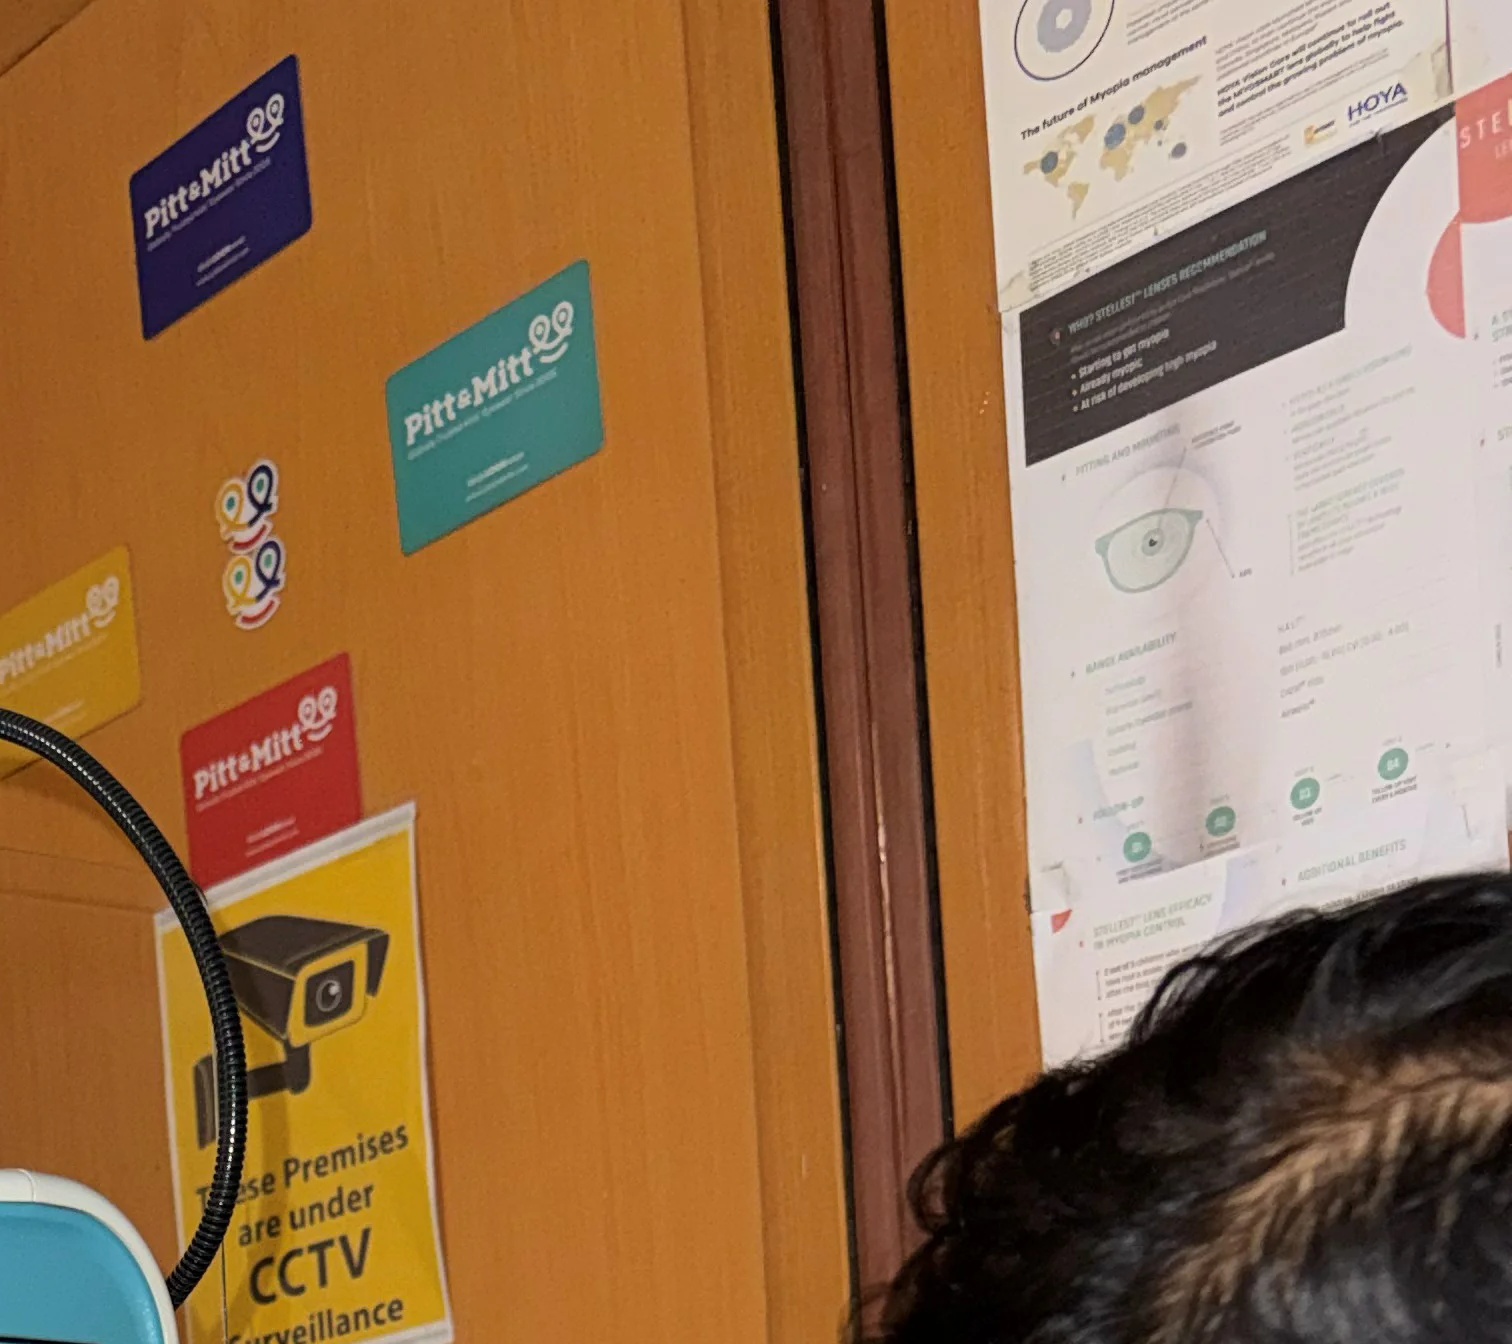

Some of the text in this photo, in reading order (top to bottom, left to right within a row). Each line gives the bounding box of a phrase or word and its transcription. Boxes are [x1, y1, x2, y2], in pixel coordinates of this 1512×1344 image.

[1021, 35, 1208, 140] The future of Myopia management
[1347, 83, 1407, 121] HOYA
[144, 139, 252, 239] Pitt&Mitt
[405, 347, 534, 446] Pitt&Mitt
[193, 723, 303, 799] Pitt&Mitt
[1298, 839, 1407, 882] ADDITIONAL BENEFITS
[196, 1124, 409, 1213] Tese Premises
[239, 1184, 374, 1247] are under
[249, 1227, 371, 1305] CCTV
